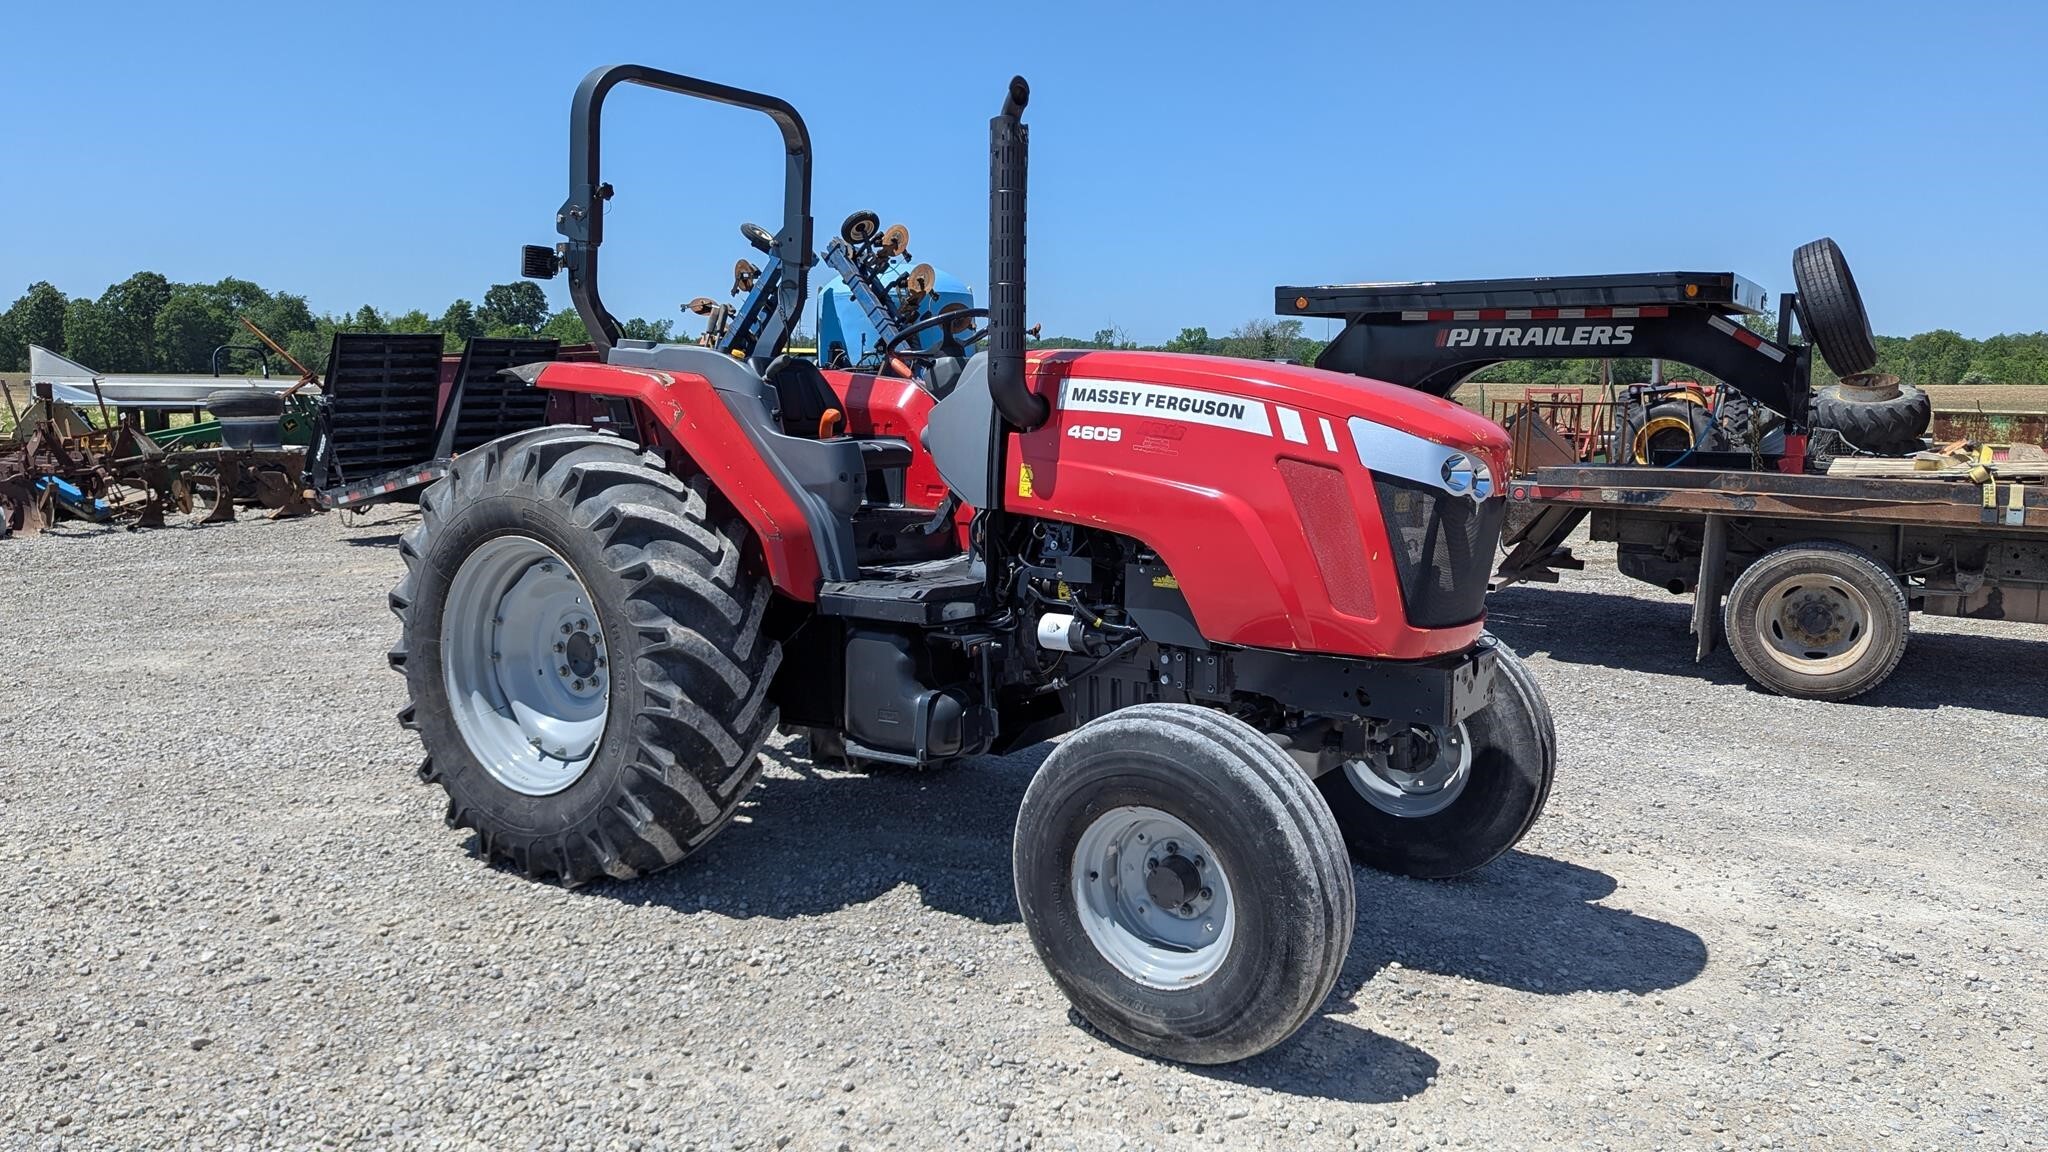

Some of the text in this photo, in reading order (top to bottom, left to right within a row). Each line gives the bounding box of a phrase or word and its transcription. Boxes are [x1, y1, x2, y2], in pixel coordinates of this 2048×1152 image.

[1446, 325, 1635, 347] PJ TRAILERS
[1071, 387, 1245, 419] MASSEY FERGUSON
[1067, 425, 1121, 441] 4609
